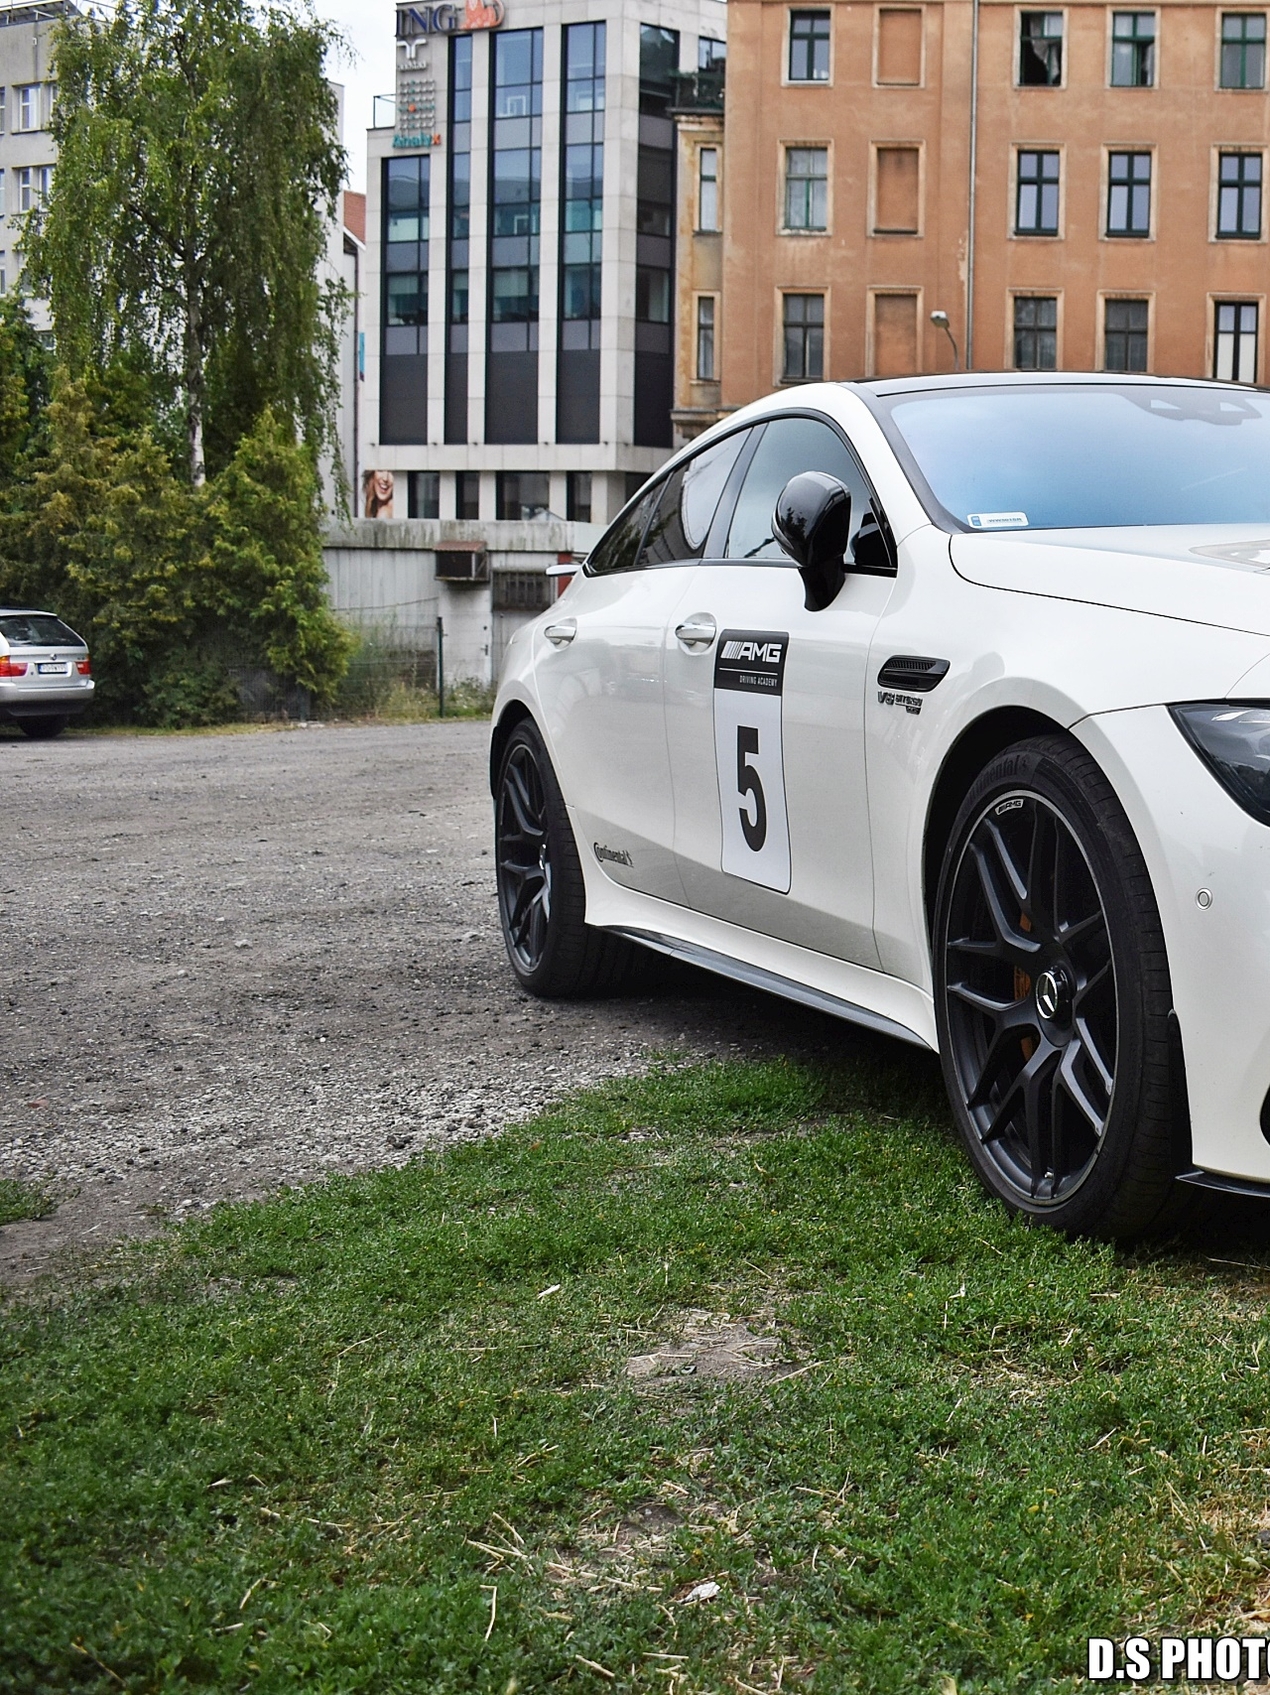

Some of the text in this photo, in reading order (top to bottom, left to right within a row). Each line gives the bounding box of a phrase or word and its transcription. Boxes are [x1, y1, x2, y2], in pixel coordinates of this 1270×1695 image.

[395, 4, 456, 37] ING
[738, 641, 782, 663] AMG
[740, 675, 778, 687] DRIVING ACADEMY
[737, 725, 767, 852] 5
